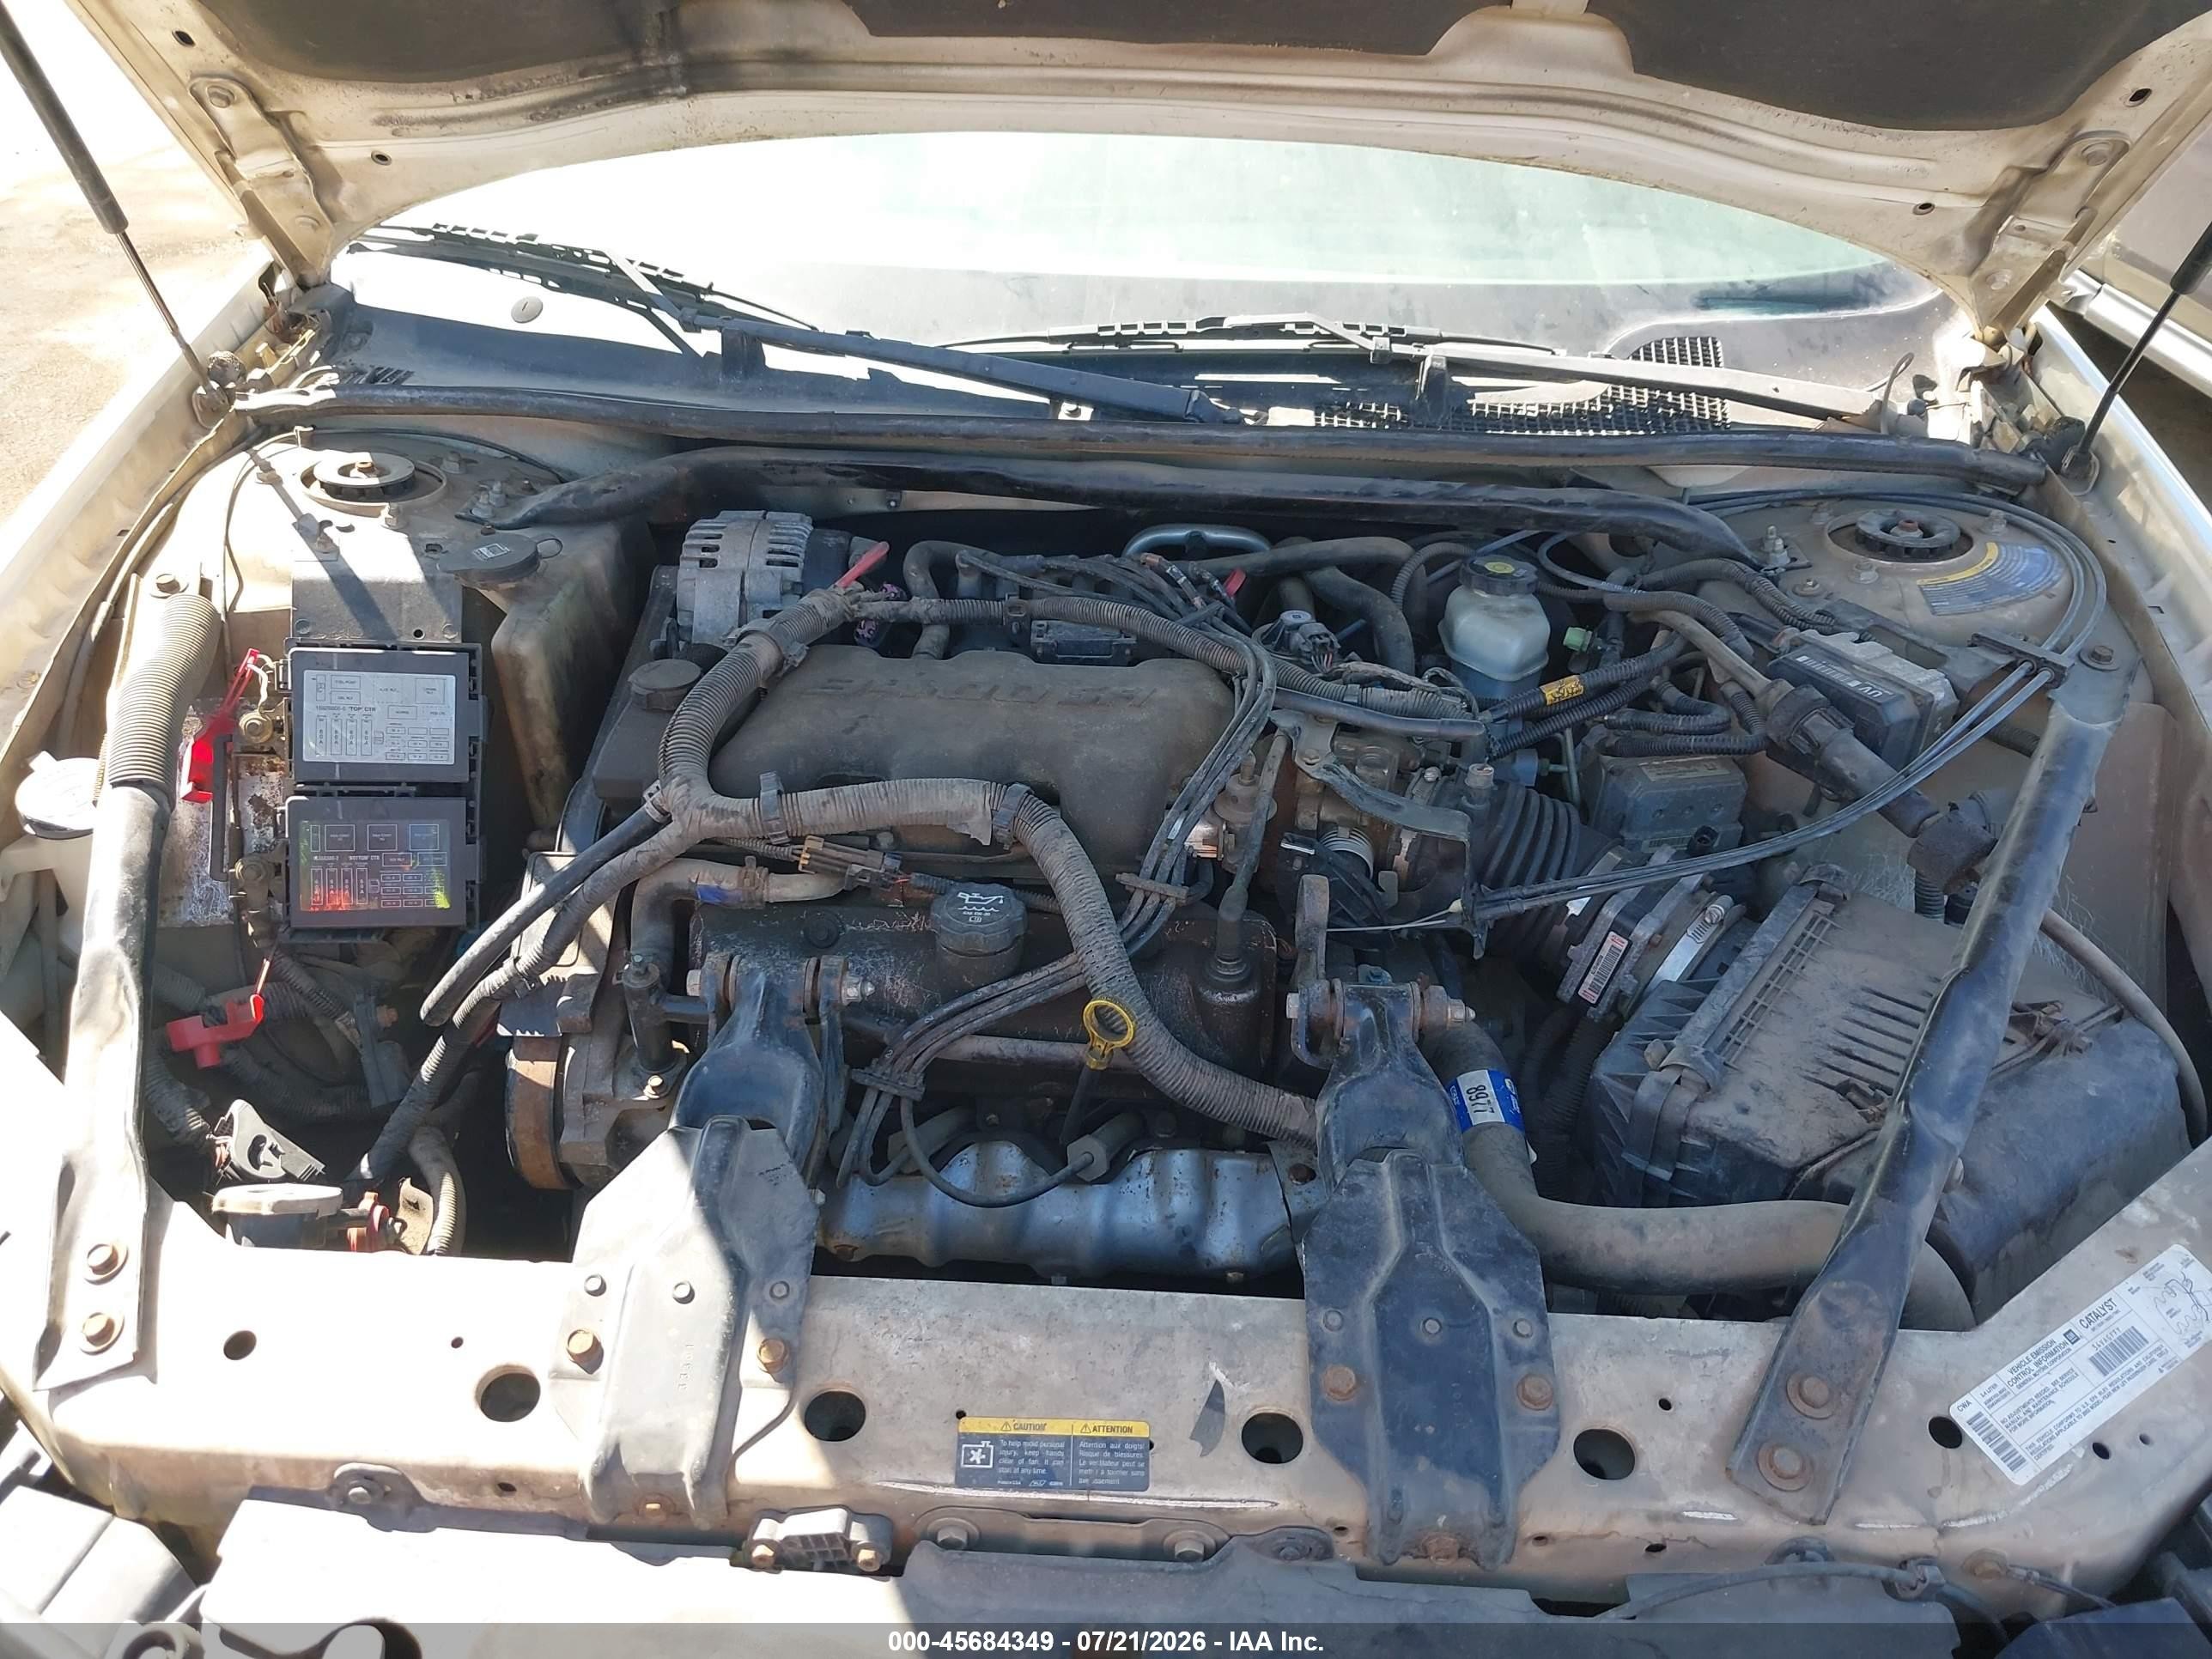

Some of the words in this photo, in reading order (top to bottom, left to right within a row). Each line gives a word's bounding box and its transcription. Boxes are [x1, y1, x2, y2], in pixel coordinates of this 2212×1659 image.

[2077, 1297, 2118, 1330] CATALYST
[2006, 1354, 2033, 1376] VEHICLE
[2029, 1337, 2057, 1359] EMISSION
[2006, 1364, 2035, 1388] CONTROL
[2032, 1339, 2069, 1369] INFORMATION
[1955, 1398, 1973, 1413] CWA
[1013, 1423, 1047, 1431] CAUTION
